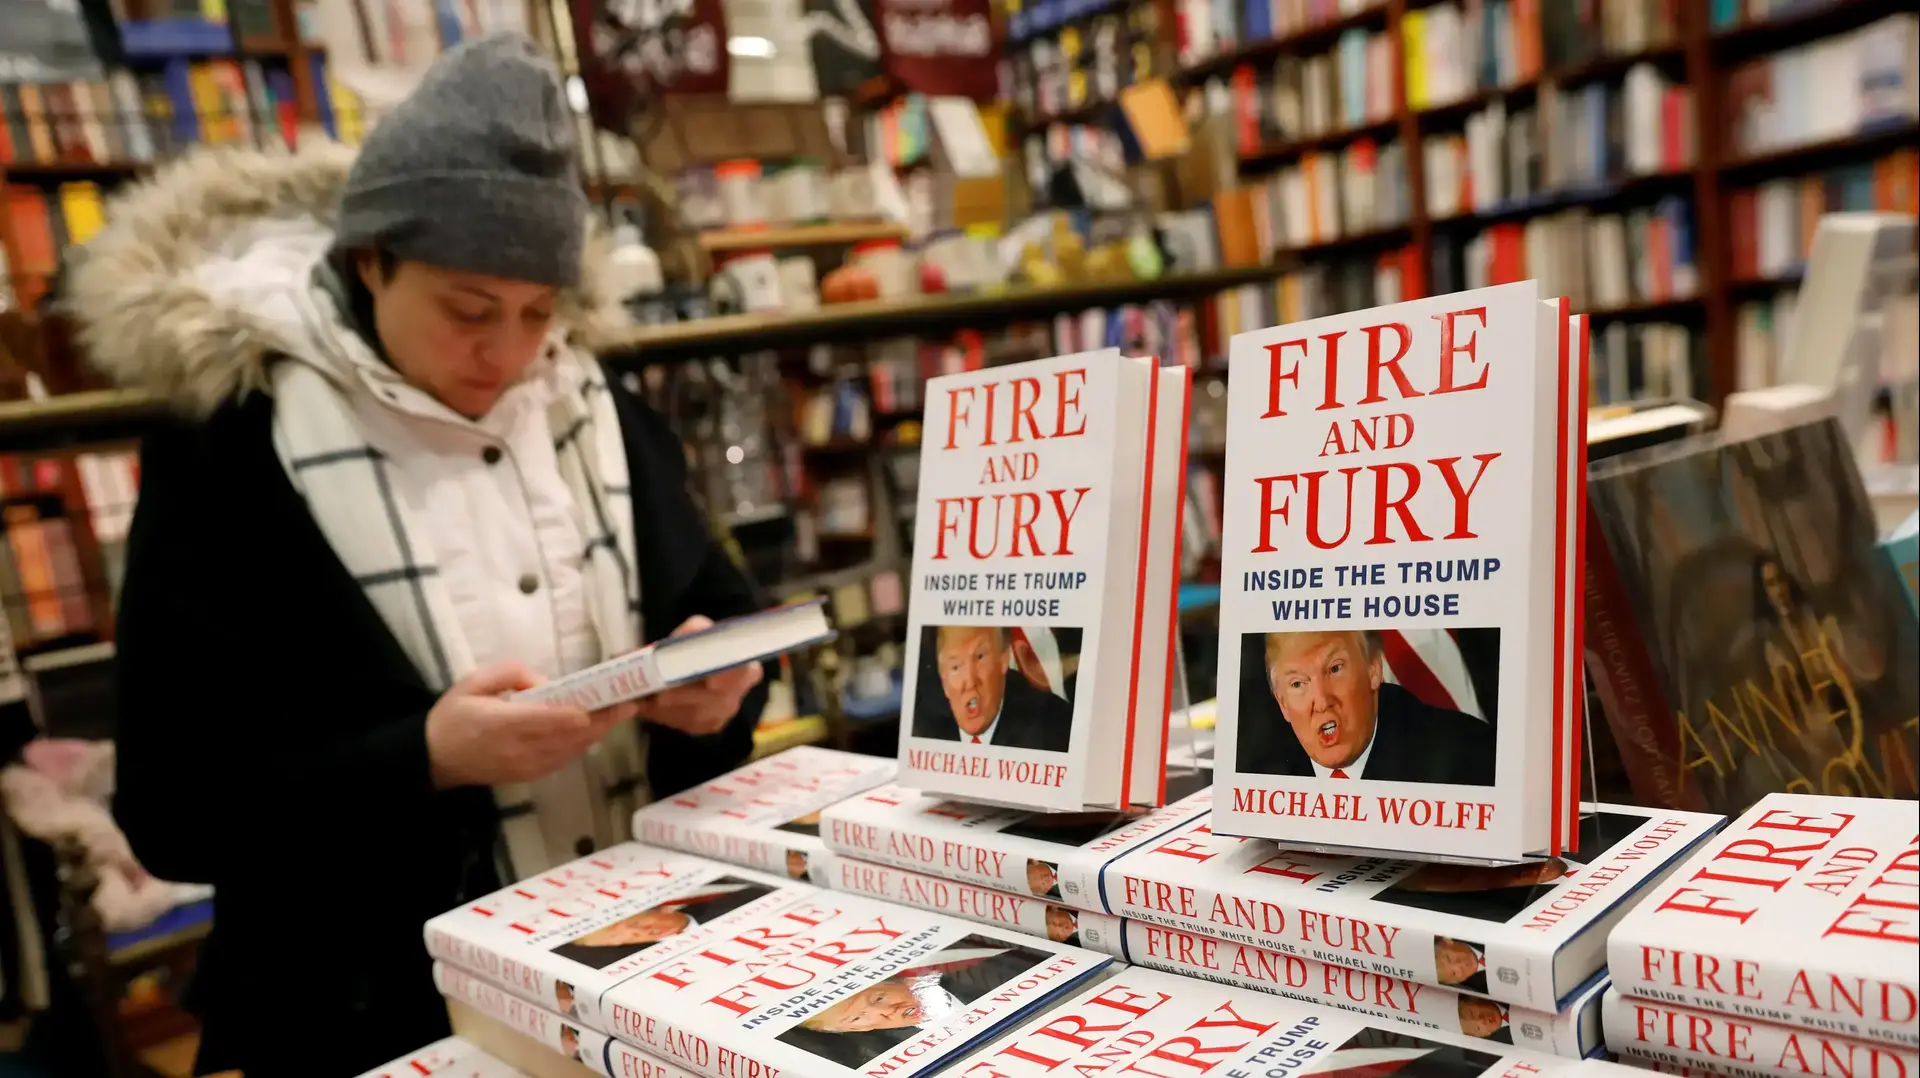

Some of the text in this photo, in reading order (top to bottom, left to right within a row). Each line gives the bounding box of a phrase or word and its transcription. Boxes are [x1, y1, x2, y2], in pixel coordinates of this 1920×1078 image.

[1260, 306, 1490, 419] FIRE
[943, 368, 1087, 450] FIRE
[1318, 412, 1415, 457] AND
[979, 451, 1039, 485] AND
[931, 487, 1092, 560] FURY
[1250, 452, 1502, 554] FURY
[924, 571, 1087, 592] INSIDE THE TRUMP
[1243, 557, 1501, 592] INSIDE THE TRUMP
[943, 598, 1060, 617] WHITE HOUSE
[1272, 594, 1460, 621] WHITE HOUSE
[907, 748, 1068, 789] MICHAEL WOLFF
[1232, 787, 1496, 831] MICHAEL WOLFF
[831, 818, 880, 851] FIRE
[887, 830, 935, 863] AND
[942, 840, 1007, 879] FURY
[1521, 818, 1689, 932] MICHAEL WOLFF
[1653, 809, 1857, 926] FIRE
[1803, 846, 1879, 897] AND
[841, 863, 1026, 926] FIRE AND FURY
[1123, 875, 1198, 918] FIRE
[1208, 893, 1286, 935] AND
[1297, 908, 1401, 960] FURY
[647, 902, 843, 992] FIRE
[701, 916, 910, 1019] FURY
[745, 936, 816, 973] AND
[1121, 908, 1414, 979] INSIDE THE TRUMP WHITE HOUSE MICHAEL WOLFF
[1145, 926, 1220, 971] FIRE
[1231, 946, 1308, 988] AND
[1322, 962, 1425, 1015] FURY
[741, 925, 942, 1030] INSIDE THE TRUMP
[785, 942, 939, 1020] WHITE HOUSE
[991, 956, 1080, 1004] WOLFF
[1143, 960, 1177, 974] INSIDE
[1179, 967, 1199, 978] THE
[1202, 973, 1239, 988] TRUMP
[1242, 981, 1279, 996] WHITE
[1281, 989, 1320, 1004] HOUSE
[1638, 944, 1918, 1024] FIRE AND
[612, 1003, 658, 1048] FIRE
[664, 1026, 709, 1068] AND
[1245, 1016, 1320, 1065] TRUMP
[1632, 985, 1919, 1044] INSIDE THE TRUMP WHITE HOUS
[1633, 1004, 1908, 1078] FIRE AND
[1073, 1030, 1156, 1078] AND
[1265, 1039, 1330, 1078] OUSE
[1625, 1046, 1680, 1065] INSIDE
[1685, 1055, 1718, 1070] THE
